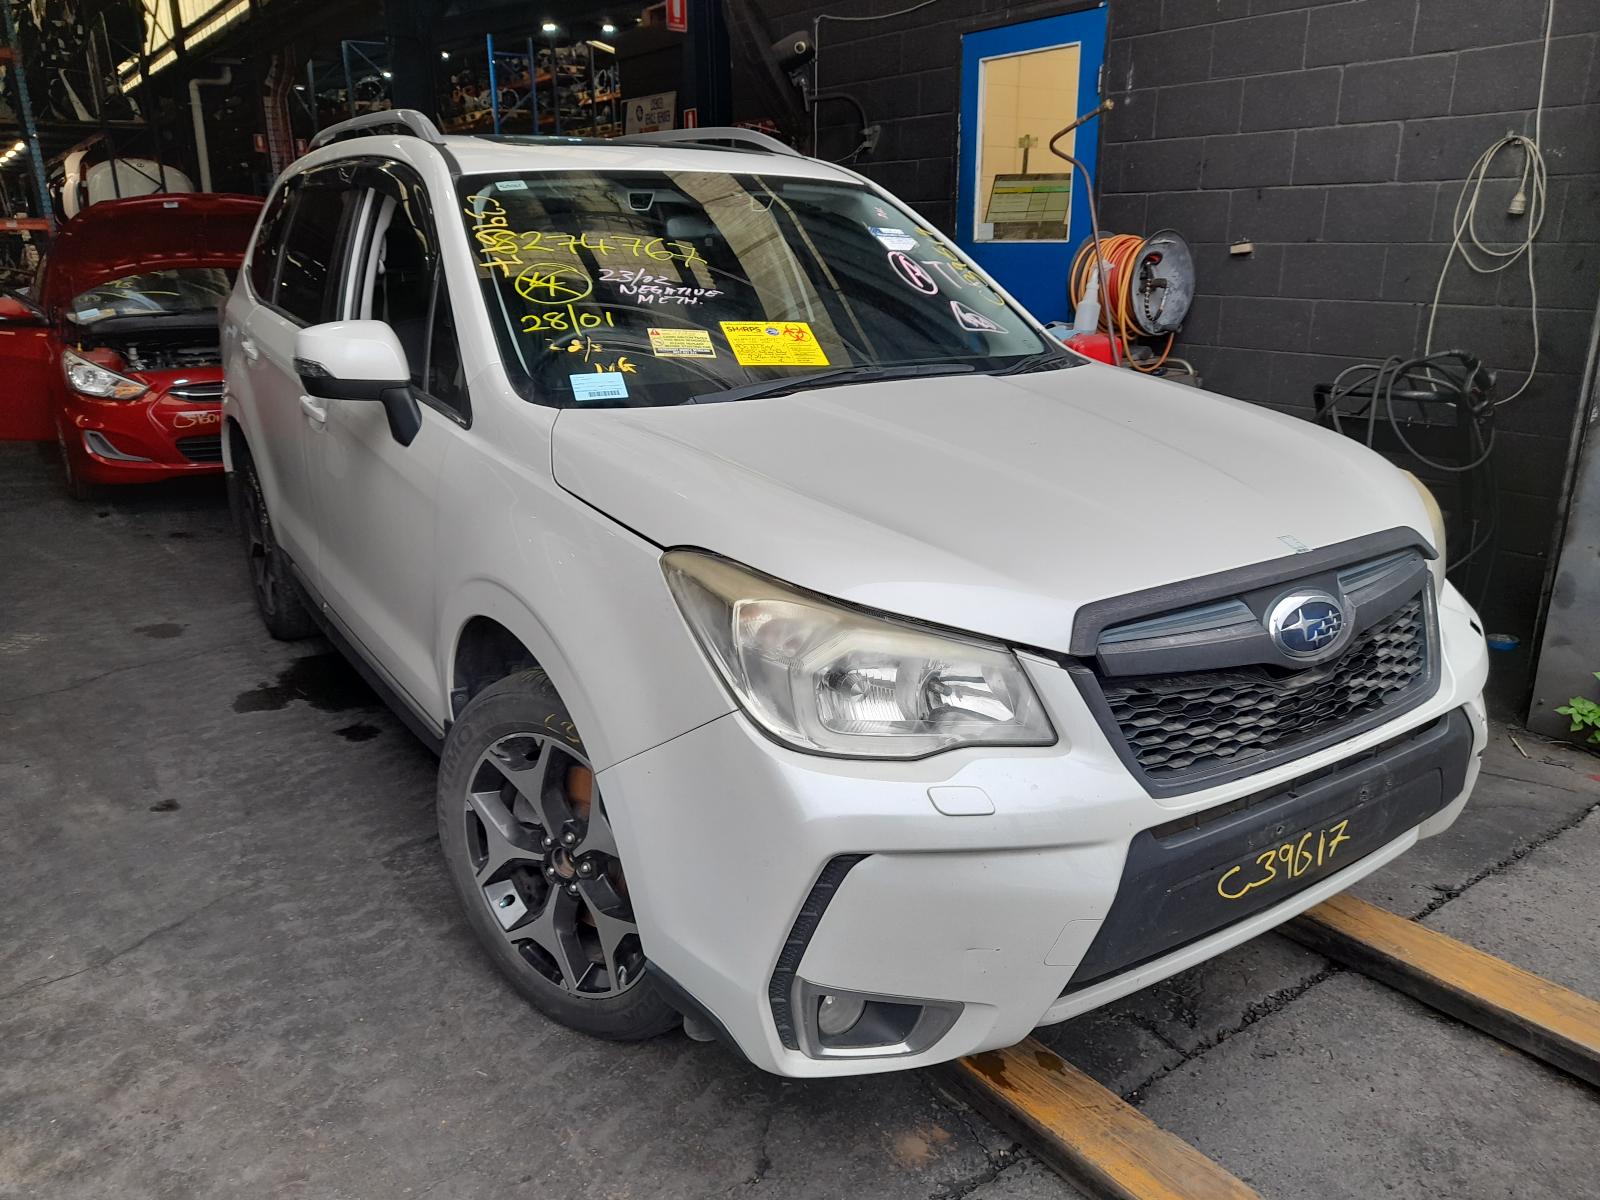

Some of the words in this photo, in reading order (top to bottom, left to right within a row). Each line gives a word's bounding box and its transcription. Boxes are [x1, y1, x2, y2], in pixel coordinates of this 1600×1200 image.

[493, 231, 708, 267] 8274767
[520, 303, 615, 337] 28/01
[1217, 819, 1350, 899] C39617
